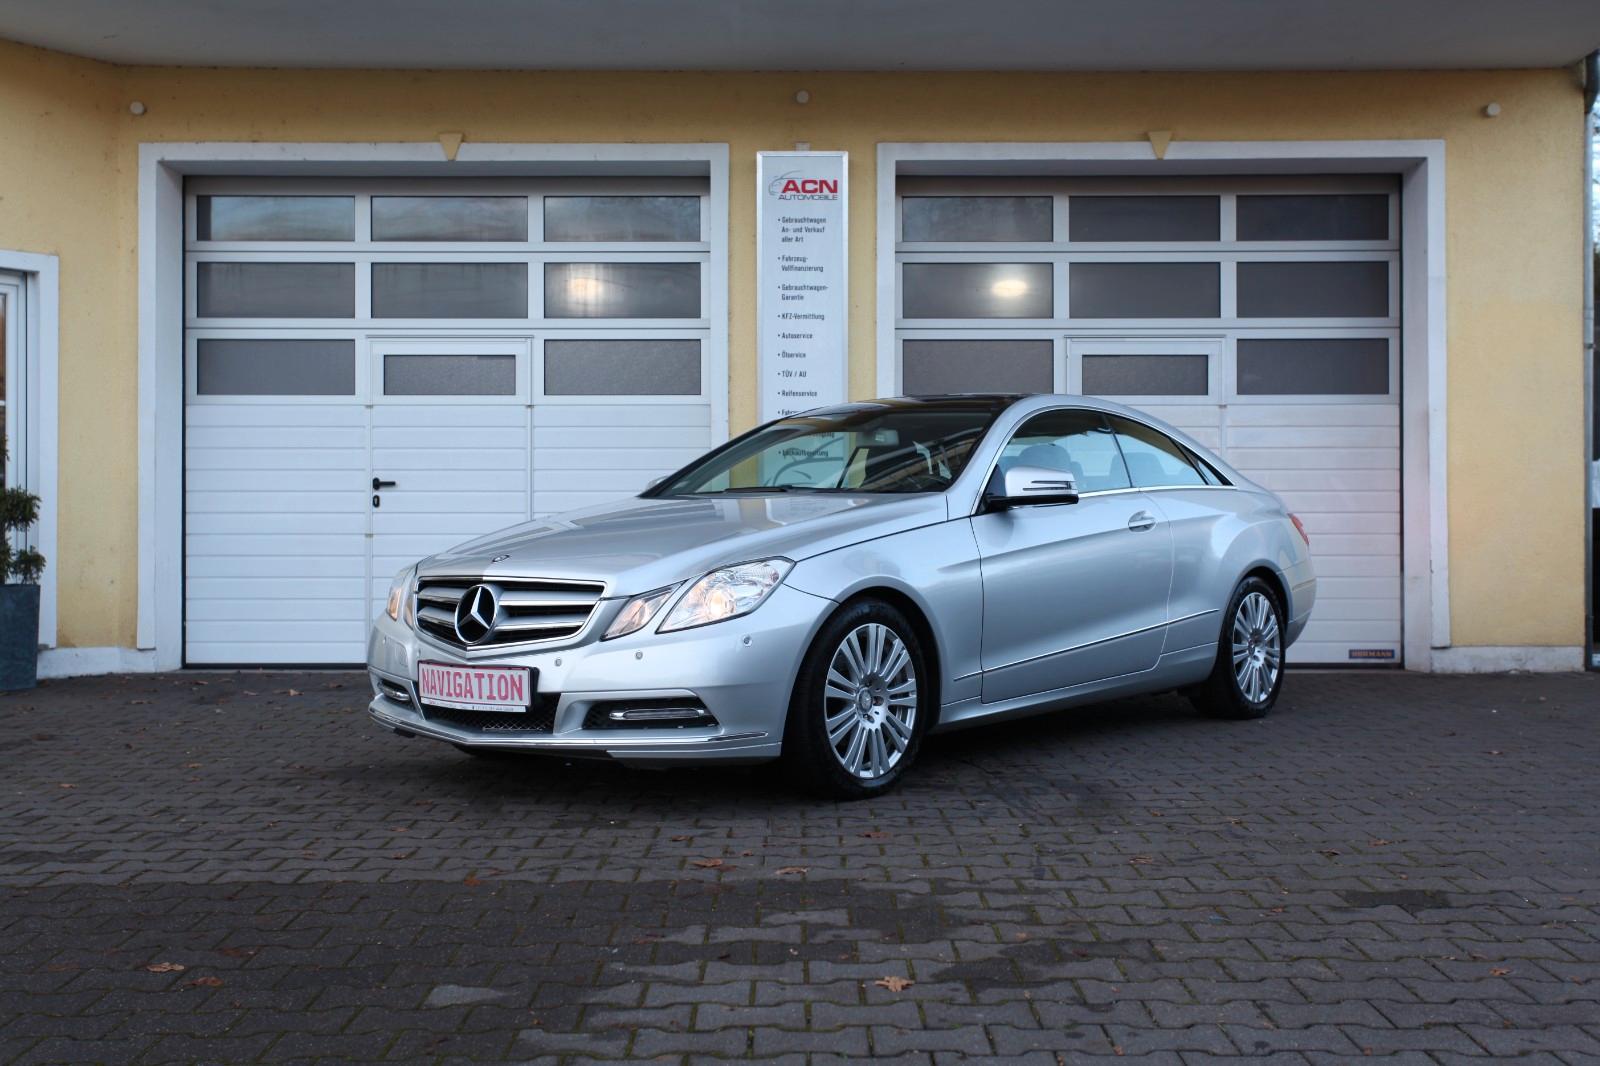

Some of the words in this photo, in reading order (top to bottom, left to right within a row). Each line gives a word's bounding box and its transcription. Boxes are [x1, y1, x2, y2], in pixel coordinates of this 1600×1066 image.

[782, 179, 838, 194] ACN
[781, 216, 827, 224] Gebrauchtwagen
[781, 265, 824, 273] Vollfinanzierung
[781, 312, 825, 321] KFZ-Vermittlung
[781, 332, 813, 340] Autoservice
[781, 350, 806, 359] Ölservice
[782, 370, 793, 378] TÜV
[799, 370, 807, 378] AU
[422, 668, 523, 701] NAVIGATION
